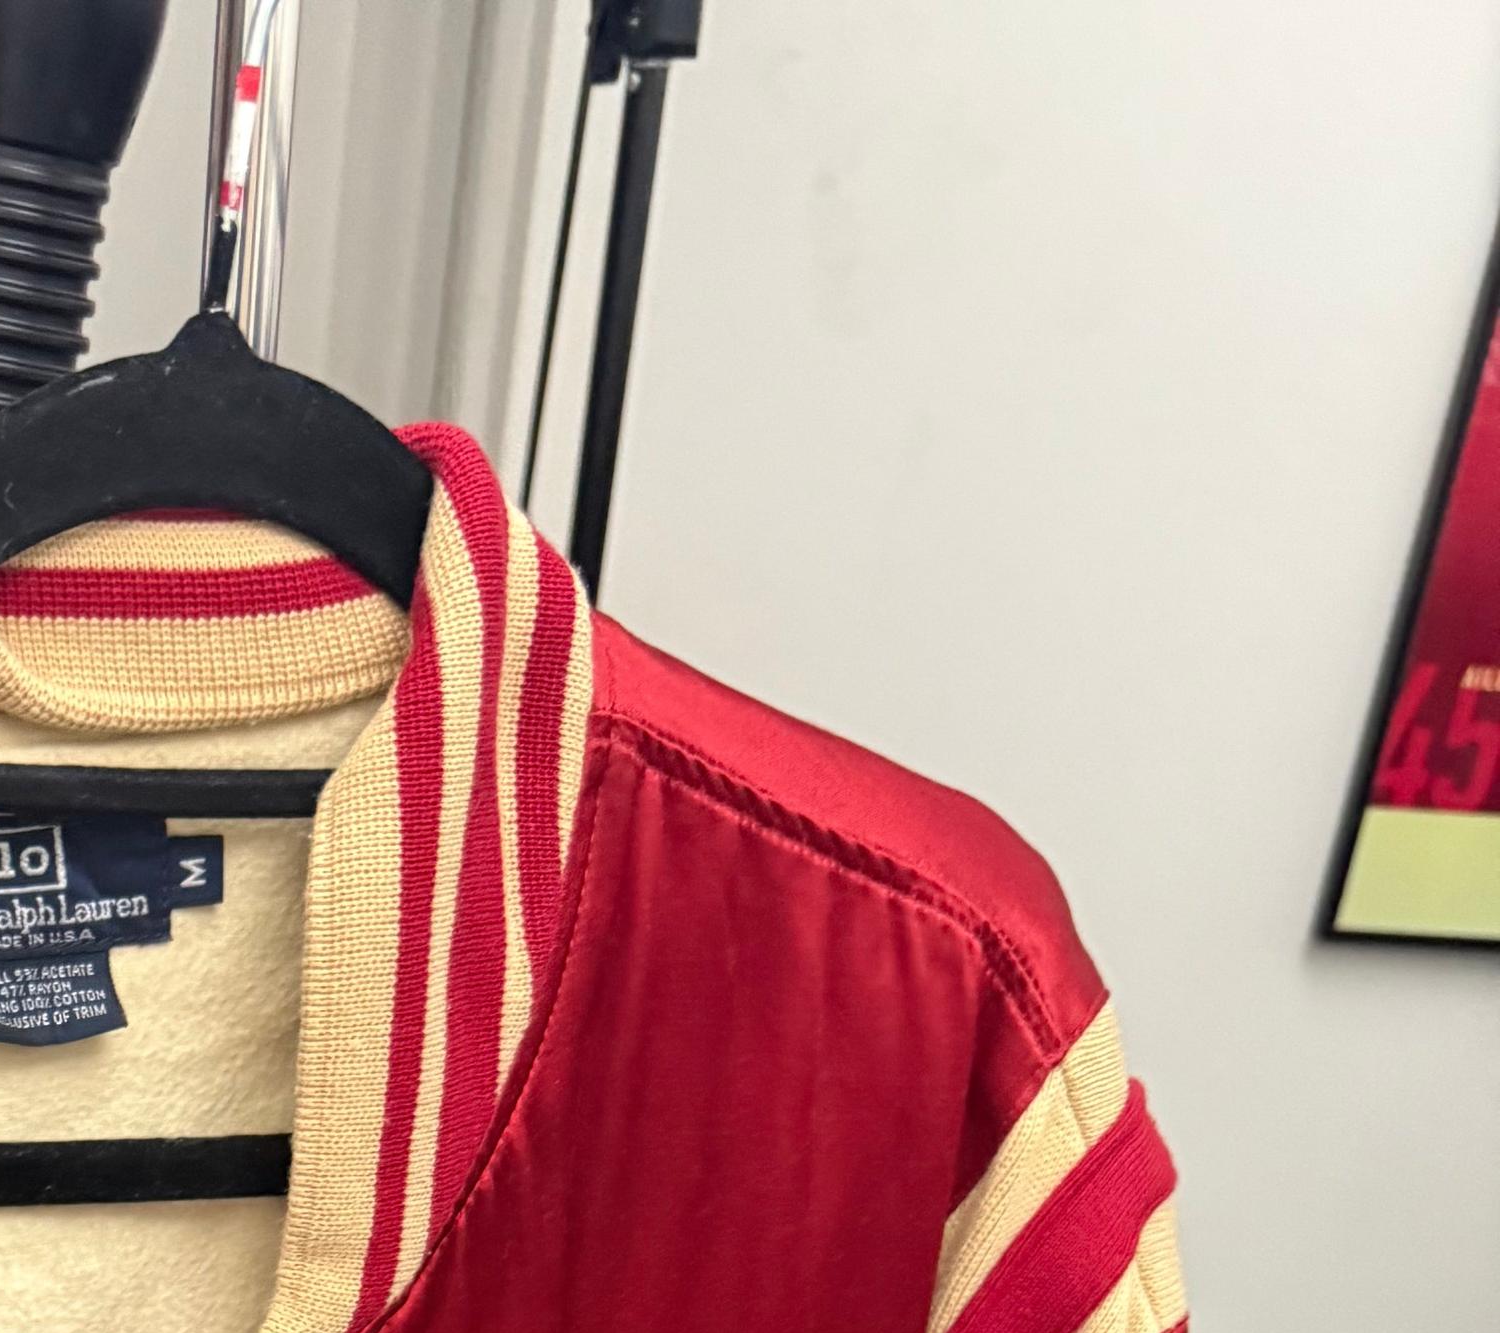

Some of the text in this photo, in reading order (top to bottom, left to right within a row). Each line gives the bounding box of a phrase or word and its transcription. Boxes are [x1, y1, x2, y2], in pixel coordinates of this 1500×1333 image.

[179, 857, 207, 888] M
[58, 895, 149, 925] Lauren
[28, 933, 44, 945] IN
[41, 964, 94, 980] ACETATE
[0, 981, 72, 998] 47% RAYON
[21, 997, 52, 1012] 100%
[53, 990, 106, 1007] COTTON
[53, 1010, 70, 1025] OF
[73, 1003, 107, 1020] TRIM
